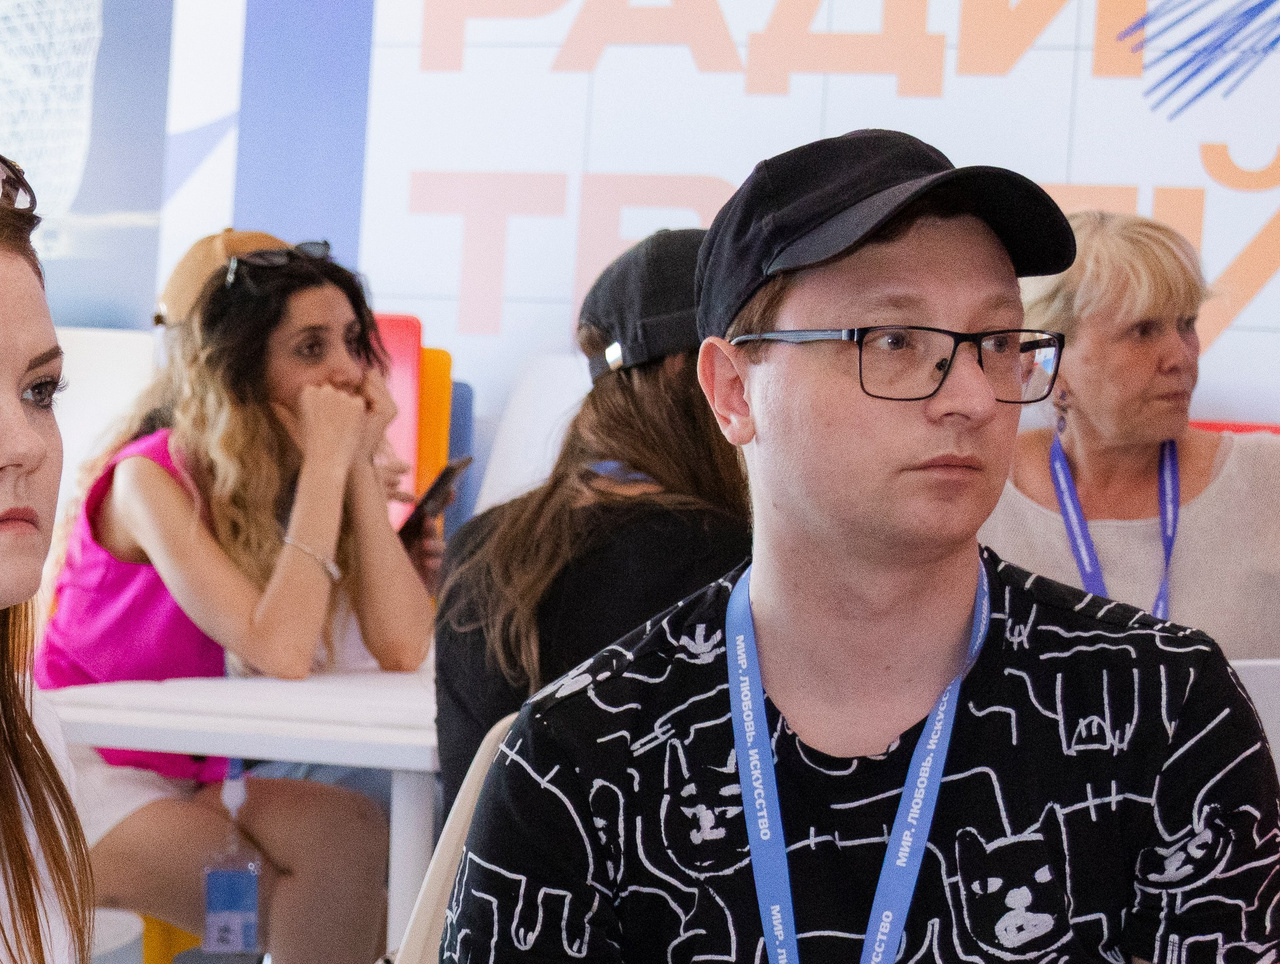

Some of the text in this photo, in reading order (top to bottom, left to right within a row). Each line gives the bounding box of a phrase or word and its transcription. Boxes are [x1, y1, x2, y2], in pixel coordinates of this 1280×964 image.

[735, 634, 771, 840] МИР. ЛЮБОВЬ. ИСКУССТВО
[895, 821, 916, 868] МИР.
[907, 752, 934, 827] ЛЮБОВЬ.
[770, 904, 785, 946] МИР.
